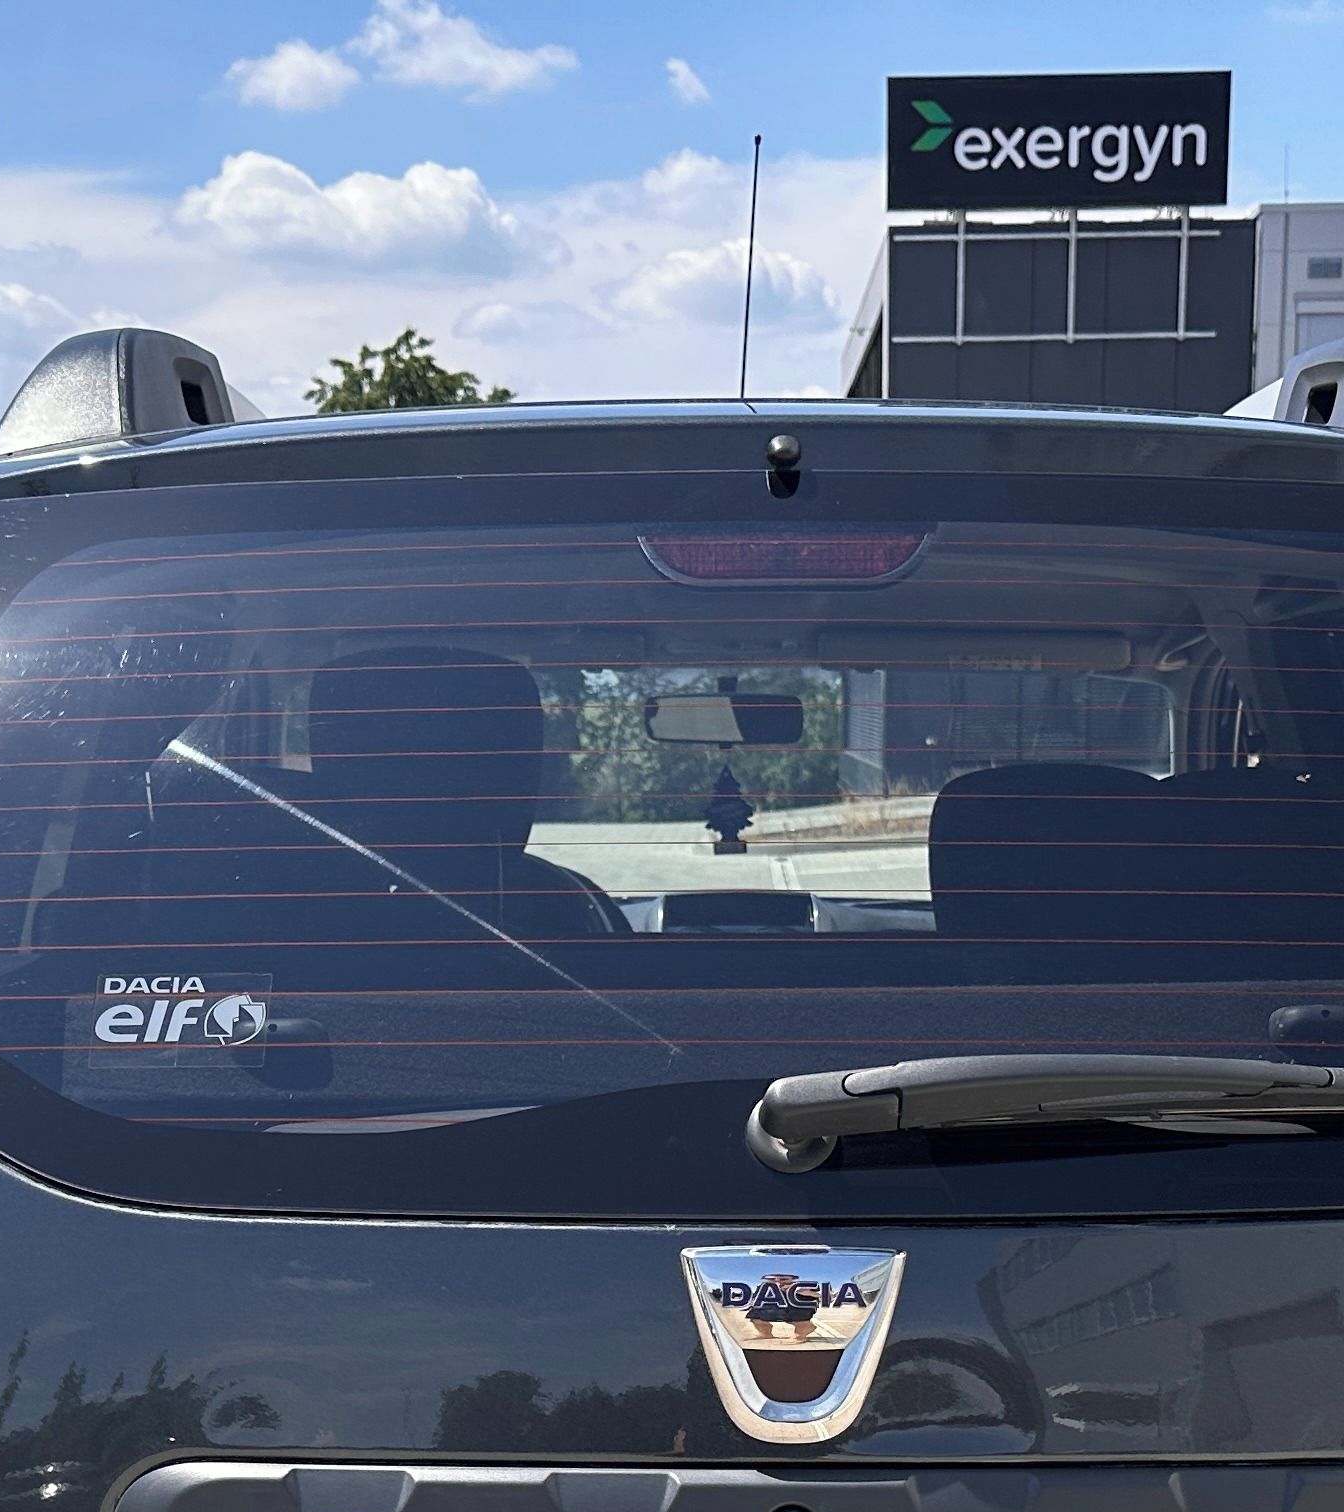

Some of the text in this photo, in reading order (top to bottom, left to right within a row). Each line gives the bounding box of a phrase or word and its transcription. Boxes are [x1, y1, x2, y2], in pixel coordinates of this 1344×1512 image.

[954, 123, 1207, 182] exergyn
[103, 976, 206, 994] DACIA
[94, 999, 205, 1043] elf
[721, 1281, 867, 1308] DACIA
